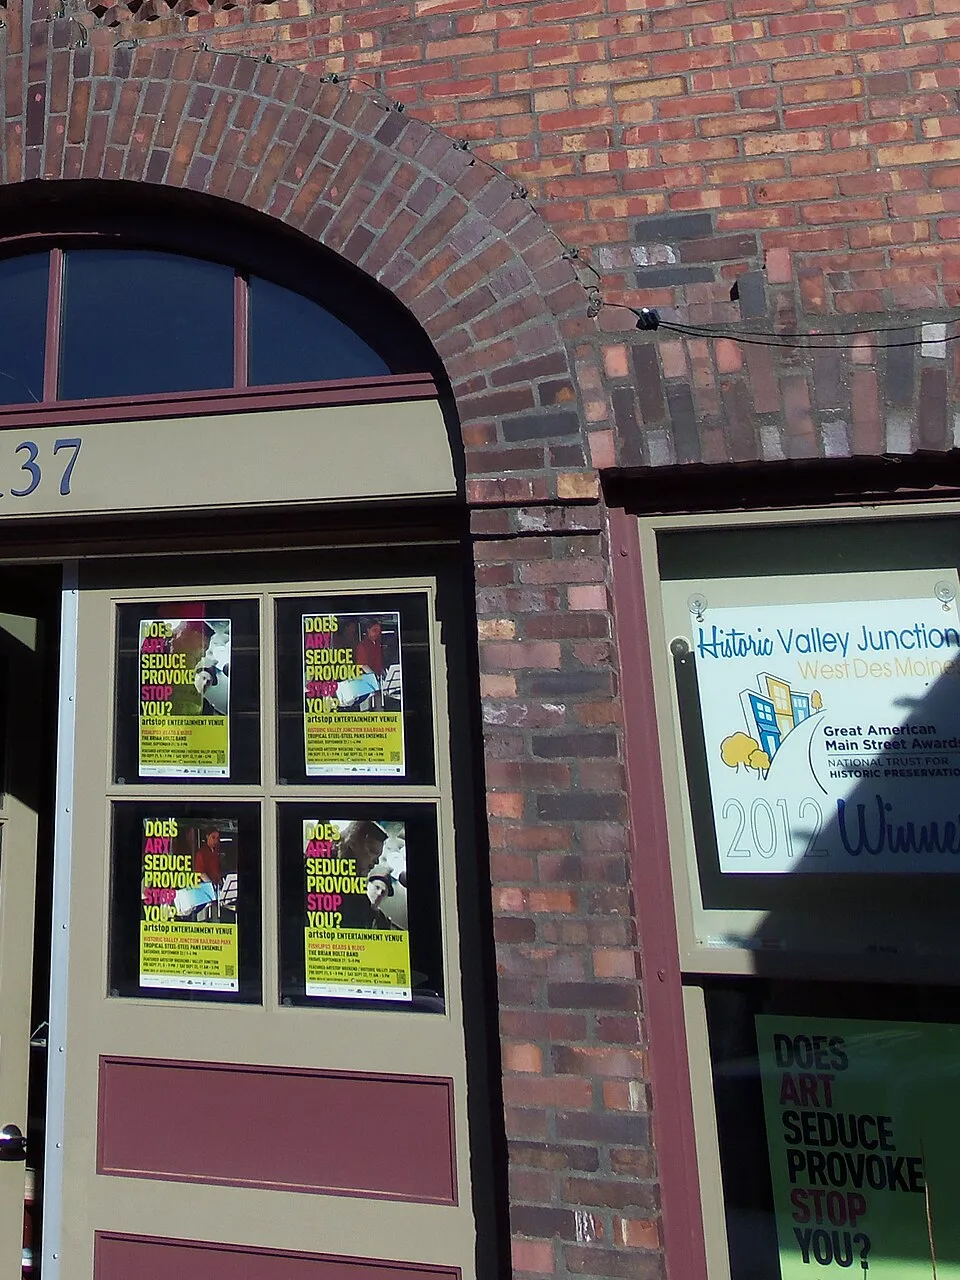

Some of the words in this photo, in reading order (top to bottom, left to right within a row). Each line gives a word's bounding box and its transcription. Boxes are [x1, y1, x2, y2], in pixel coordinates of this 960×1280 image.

[144, 621, 173, 638] DOES
[305, 617, 338, 633] DOES
[142, 638, 165, 653] ART
[305, 632, 330, 649] ART
[697, 626, 774, 659] Historic
[777, 627, 850, 657] Valley
[857, 622, 960, 652] Junction
[142, 653, 186, 669] SEDUCE
[306, 648, 353, 665] SEDUCE
[142, 669, 195, 685] PROVOKE
[306, 664, 363, 681] PROVOKE
[798, 660, 850, 680] West
[854, 659, 893, 678] Des
[142, 685, 173, 701] STOP
[306, 681, 338, 698] STOP
[141, 701, 173, 716] YOU?
[306, 698, 339, 714] YOU?
[142, 718, 166, 727] artstop
[308, 716, 332, 724] artstop
[823, 726, 862, 737] Great
[868, 725, 936, 736] American
[826, 739, 859, 751] Main
[863, 738, 906, 751] Street
[828, 758, 884, 767] NATIONAL
[886, 758, 922, 766] TRUST
[925, 757, 948, 766] FOR
[830, 769, 880, 778] HISTORIC
[884, 769, 960, 778] PRESERVATIO
[145, 821, 178, 838] DOES
[306, 823, 340, 840] DOES
[721, 797, 832, 858] 2012
[837, 795, 960, 857] Winne
[144, 838, 171, 854] ART
[306, 841, 331, 857] ART
[144, 854, 192, 872] SEDUCE
[306, 858, 356, 876] SEDUCE
[144, 871, 201, 888] PROVOKE
[307, 877, 368, 894] PROVOKE
[144, 888, 176, 905] STOP
[308, 894, 342, 912] STOP
[143, 905, 176, 922] YOU?
[307, 911, 342, 928] YOU?
[144, 924, 169, 934] artstop
[171, 926, 214, 934] ENTERTAINMENT
[308, 931, 335, 941] artstop
[337, 932, 382, 940] ENTERTAINMENT
[385, 934, 403, 942] VENUE
[773, 1034, 849, 1071] DOES
[780, 1072, 836, 1108] ART
[782, 1110, 897, 1152] SEDUCE
[786, 1149, 926, 1194] PROVOKE
[790, 1188, 867, 1228] STOP
[793, 1228, 871, 1270] YOU?
